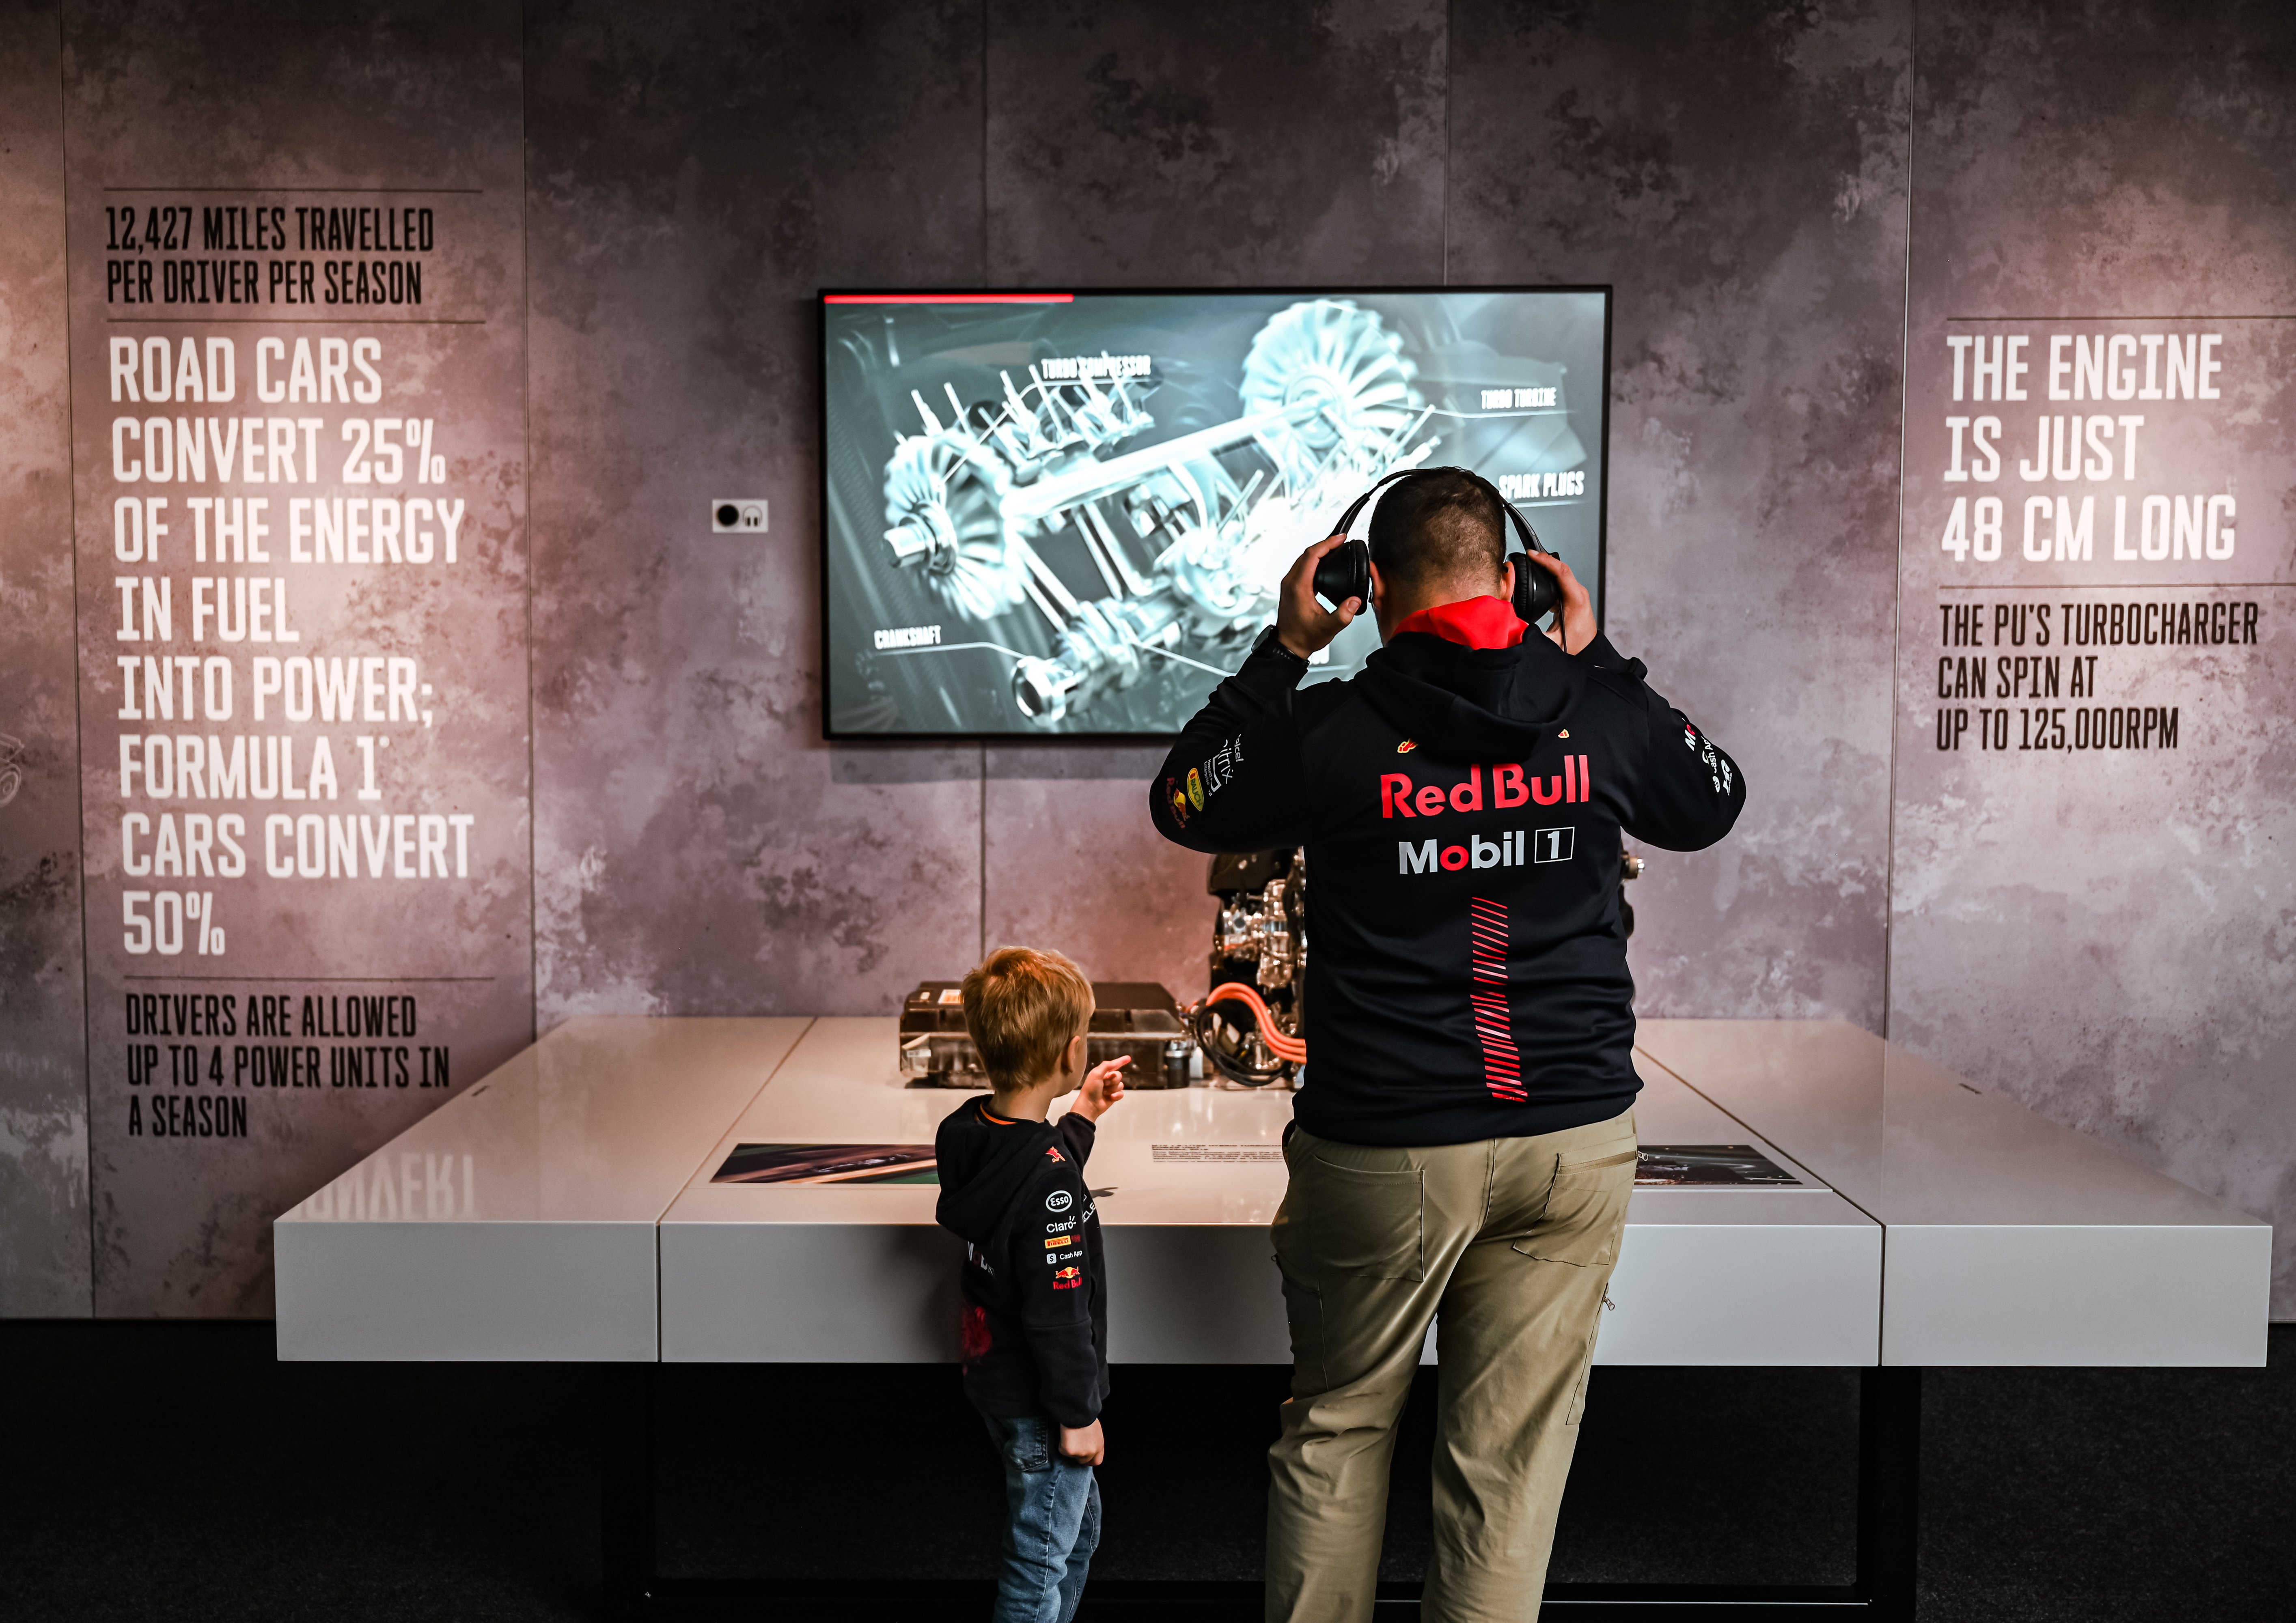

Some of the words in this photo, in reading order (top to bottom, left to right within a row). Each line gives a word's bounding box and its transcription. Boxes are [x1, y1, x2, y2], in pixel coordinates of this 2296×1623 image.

[106, 207, 193, 254] 12,427
[203, 207, 285, 251] MILES
[295, 207, 433, 252] TRAVELLED
[108, 260, 153, 304] PER
[163, 260, 259, 304] DRIVER
[269, 260, 315, 304] PER
[325, 260, 421, 305] SEASON
[110, 337, 235, 403] ROAD
[256, 337, 382, 403] CARS
[1947, 335, 2029, 401] THE
[2048, 334, 2222, 400] ENGINE
[112, 417, 323, 483] CONVERT
[342, 418, 446, 484] 25%
[1944, 416, 2001, 482] IS
[2020, 415, 2144, 482] JUST
[1498, 473, 1540, 500] SPARK
[1543, 471, 1585, 497] PLUGS
[114, 497, 168, 562] OF
[187, 498, 269, 562] THE
[289, 498, 465, 564] ENERGY
[1942, 496, 2003, 562] 48
[2023, 496, 2094, 561] CM
[2114, 494, 2236, 560] LONG
[115, 577, 171, 641] IN
[192, 577, 300, 642] FUEL
[1940, 604, 1983, 647] THE
[1994, 603, 2051, 646] PU'S
[2061, 602, 2259, 646] TURBOCHARGER
[873, 625, 941, 650] CRANKSHAFT
[118, 656, 232, 721] INTO
[253, 657, 433, 728] POWER;
[1937, 657, 1986, 699] CAN
[1997, 656, 2060, 698] SPIN
[2070, 655, 2098, 697] AT
[1936, 708, 1968, 750] UP
[1979, 708, 2008, 750] TO
[2019, 706, 2179, 754] 125,000RPM
[120, 735, 337, 799] FORMULA
[1380, 764, 1483, 818] Red
[1493, 755, 1589, 808] Bull
[1190, 778, 1203, 807] RAUCH
[122, 813, 246, 877] CARS
[266, 814, 474, 878] CONVERT
[1399, 831, 1524, 874] Mobil
[123, 891, 225, 954] 50%
[126, 994, 236, 1036] DRIVERS
[247, 995, 291, 1037] ARE
[302, 995, 416, 1037] ALLOWED
[127, 1044, 158, 1086] UP
[169, 1045, 198, 1086] TO
[209, 1045, 224, 1086] 4
[235, 1045, 321, 1087] POWER
[331, 1046, 409, 1088] UNITS
[419, 1046, 449, 1088] IN
[128, 1095, 143, 1136] A
[152, 1095, 246, 1137] SEASON
[1050, 1195, 1069, 1207] Esso
[1046, 1219, 1075, 1233] Claro
[1047, 1237, 1069, 1247] PIRELLI
[1059, 1252, 1073, 1261] Cash
[1053, 1280, 1070, 1290] Red
[1071, 1277, 1083, 1288] Bull
